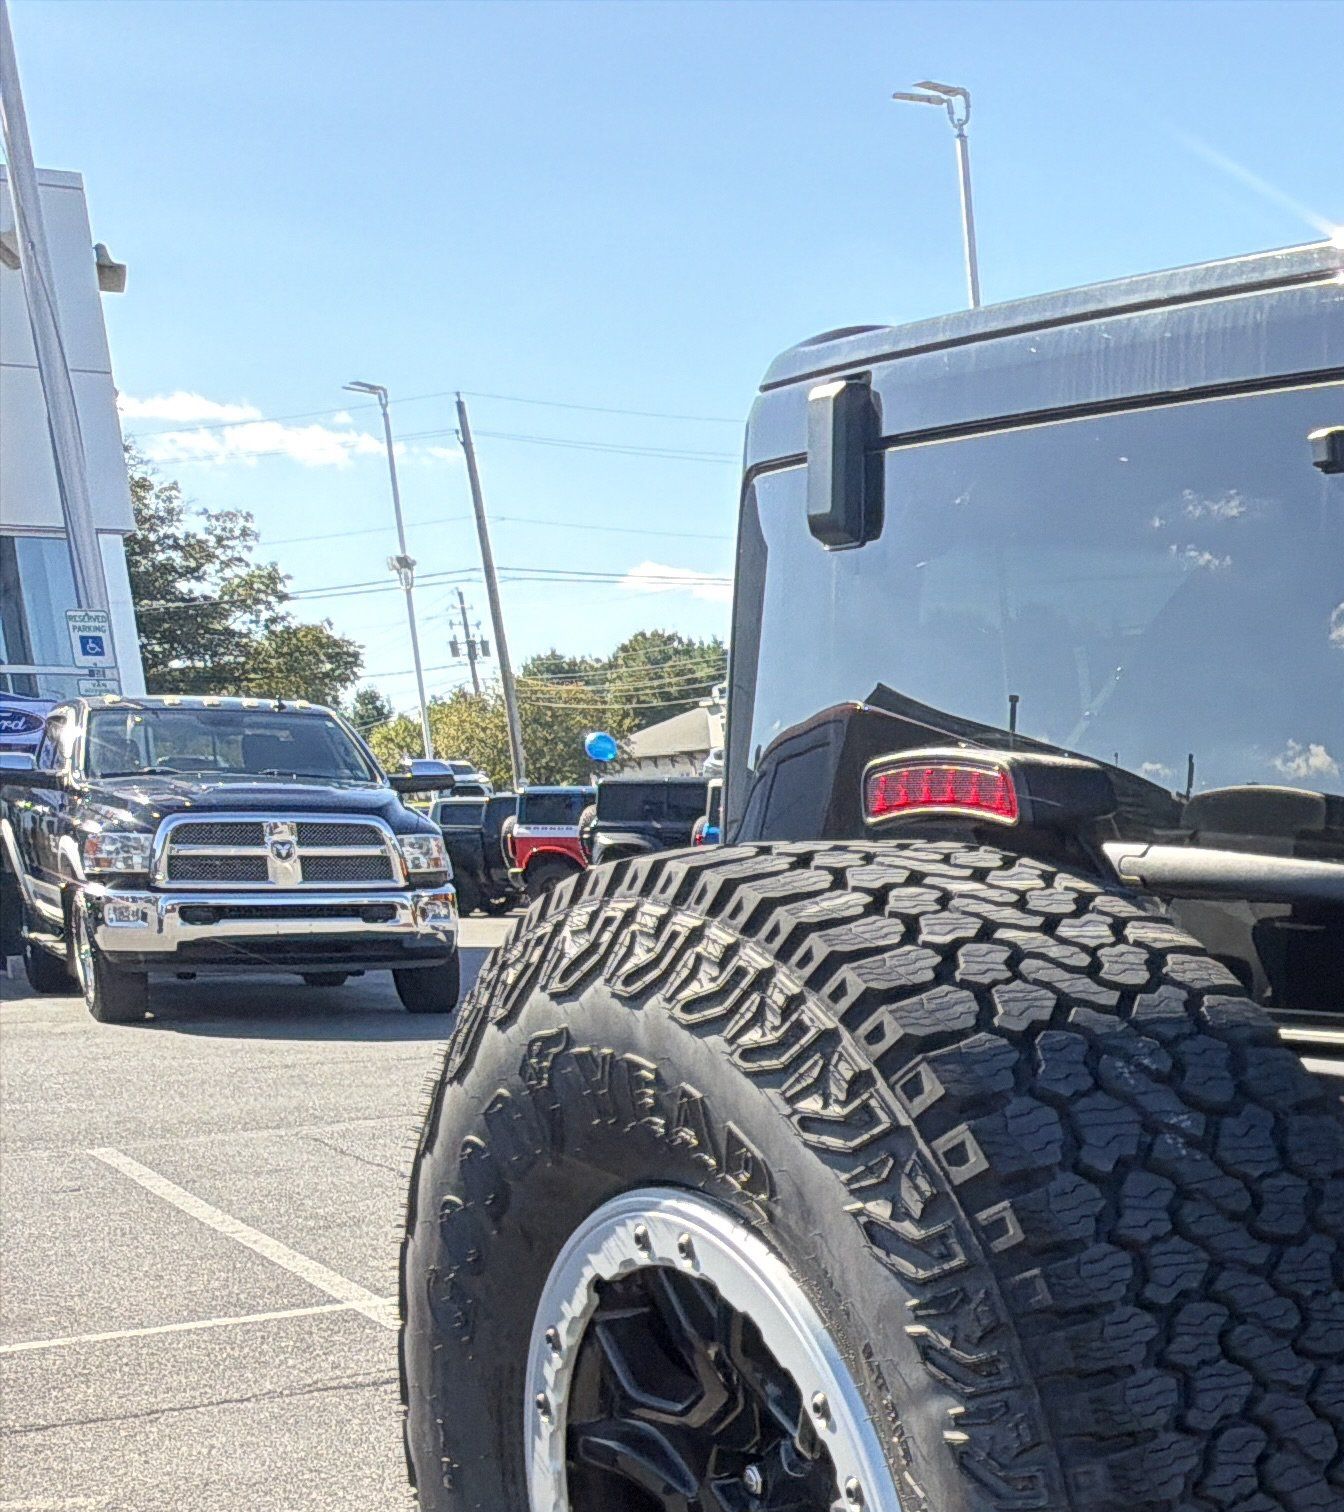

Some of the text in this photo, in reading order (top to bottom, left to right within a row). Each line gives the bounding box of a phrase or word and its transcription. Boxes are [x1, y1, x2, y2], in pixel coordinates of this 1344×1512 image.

[68, 613, 108, 623] RESERVED
[71, 624, 107, 634] PARKING
[0, 712, 26, 730] rd
